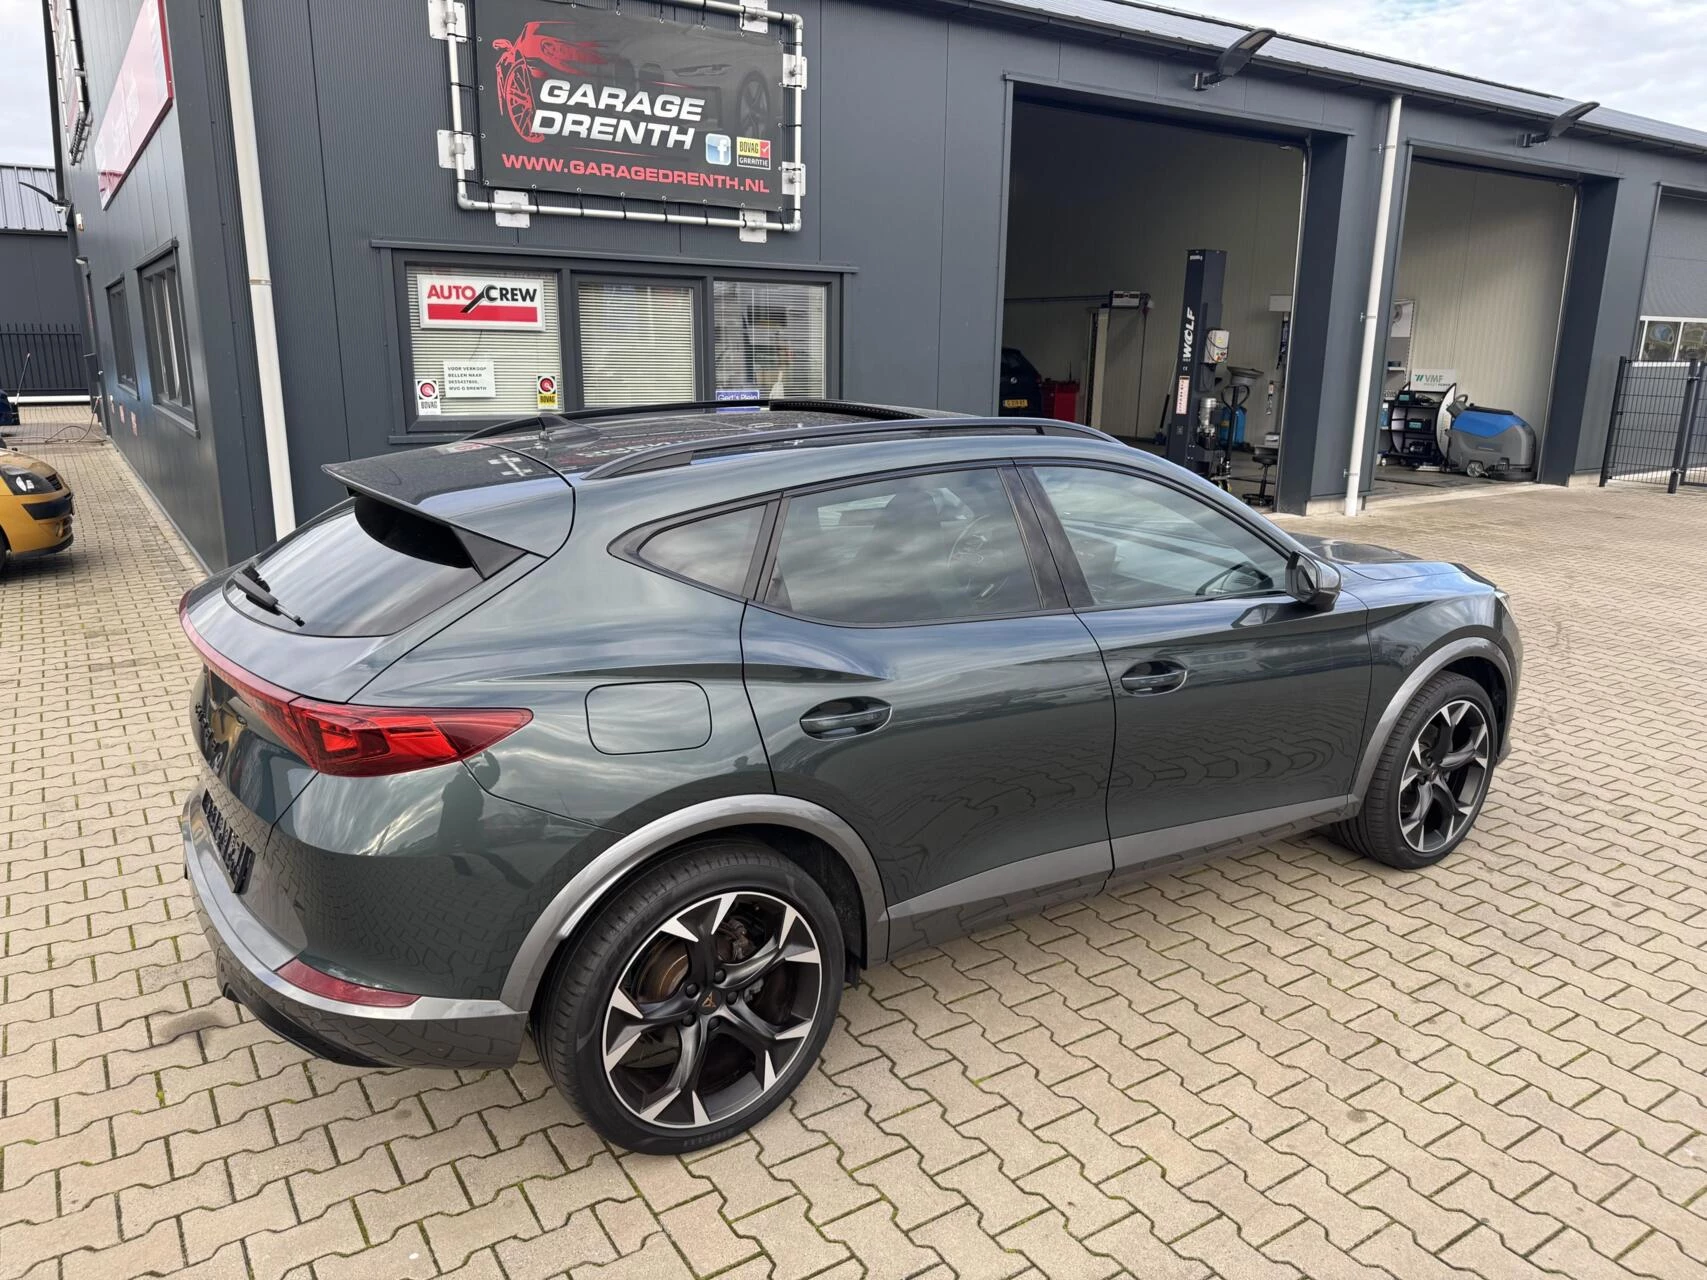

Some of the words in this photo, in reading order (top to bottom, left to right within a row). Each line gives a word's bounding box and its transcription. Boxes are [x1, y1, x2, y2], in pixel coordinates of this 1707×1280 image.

[539, 79, 705, 122] GARAGE
[531, 109, 696, 150] DRENTH
[740, 141, 759, 154] BOVAG
[739, 157, 769, 167] GARANTIE
[502, 153, 770, 193] WWW.GARAGEDRENTH.NL
[427, 284, 477, 300] AUTO
[484, 285, 537, 302] CREW
[1182, 307, 1195, 358] WOLF
[420, 401, 438, 409] BOVAG
[540, 395, 556, 404] BOVAG
